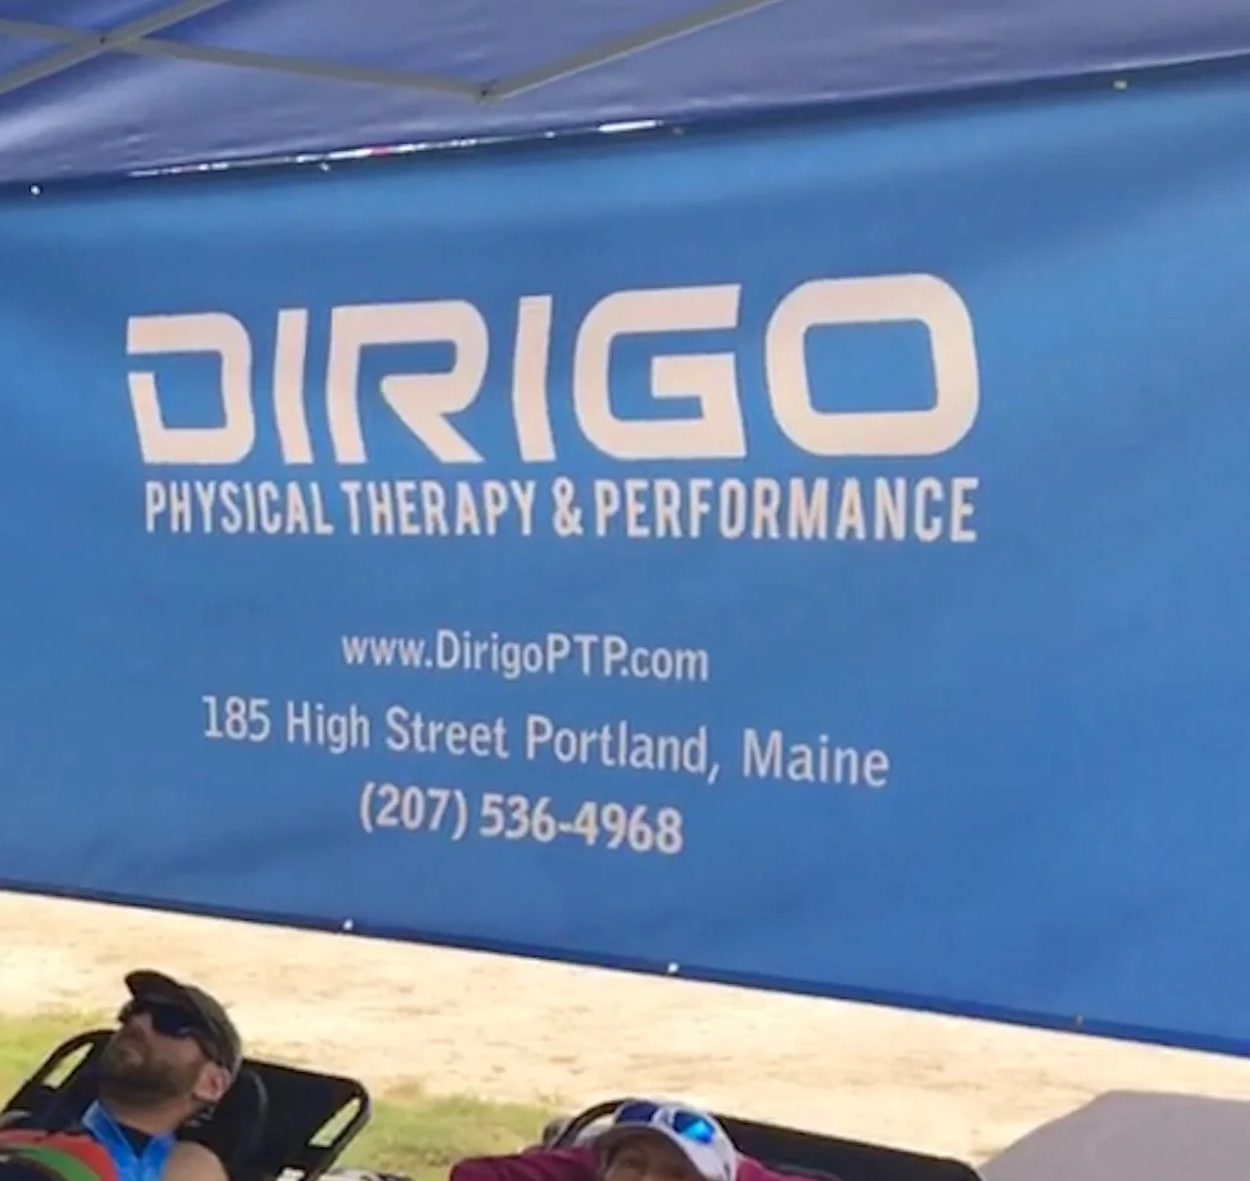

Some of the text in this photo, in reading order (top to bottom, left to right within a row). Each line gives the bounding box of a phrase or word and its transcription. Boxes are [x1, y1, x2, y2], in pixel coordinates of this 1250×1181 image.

[126, 272, 981, 465] DIRIGO
[145, 476, 980, 542] PHYSICAL THERAPY & PERFORMANCE
[341, 629, 709, 681] www.DirigoPTP.com
[202, 695, 890, 788] 185 High Street Portland, Maine
[359, 781, 684, 855] (207) 536-4968
